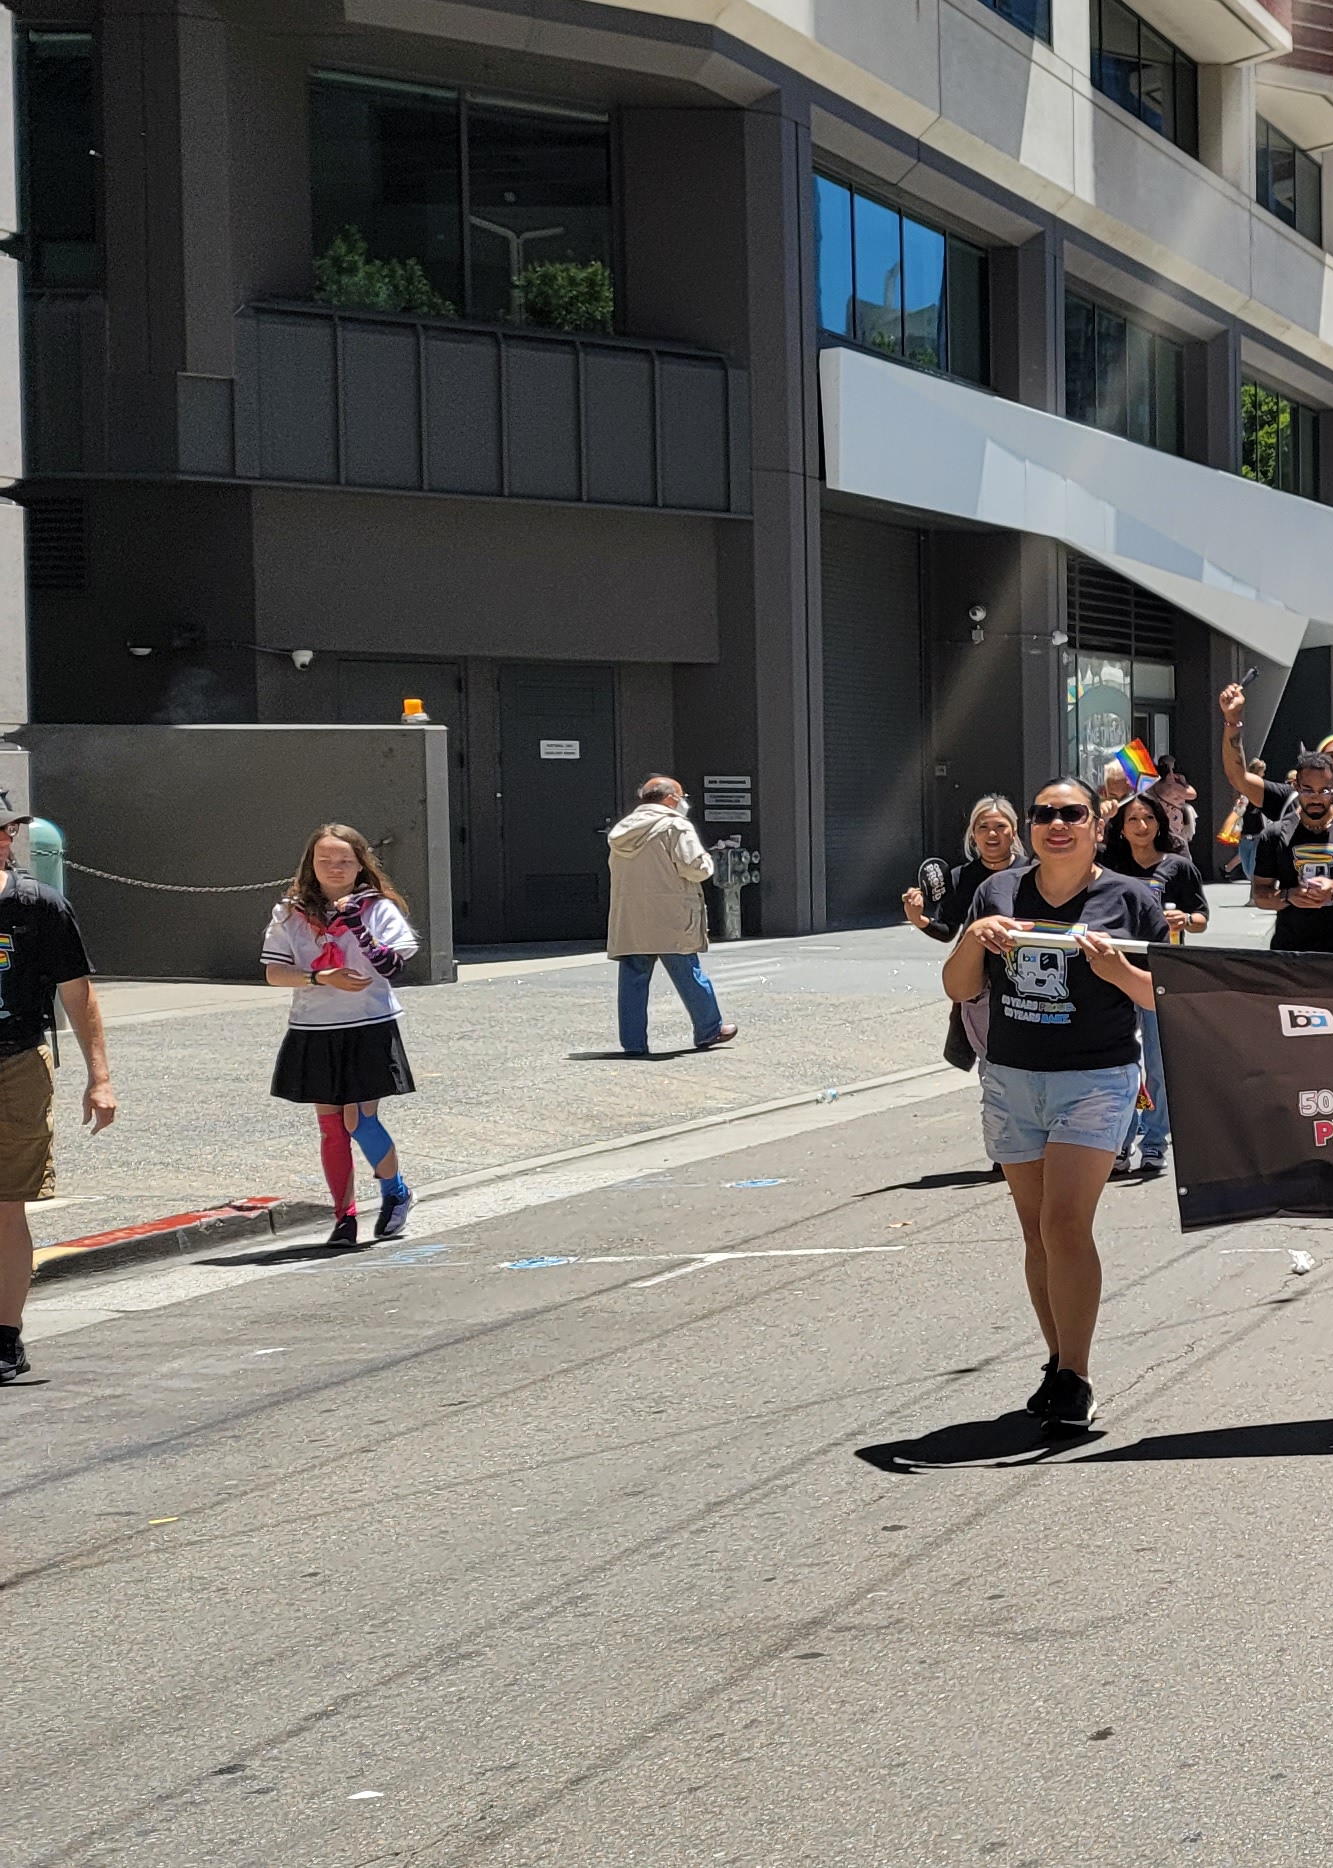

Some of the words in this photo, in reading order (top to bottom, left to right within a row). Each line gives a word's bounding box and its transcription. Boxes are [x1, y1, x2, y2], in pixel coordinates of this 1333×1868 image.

[924, 864, 942, 901] PROUD
[1010, 996, 1038, 1010] YEARS
[1013, 1008, 1041, 1022] YEARS
